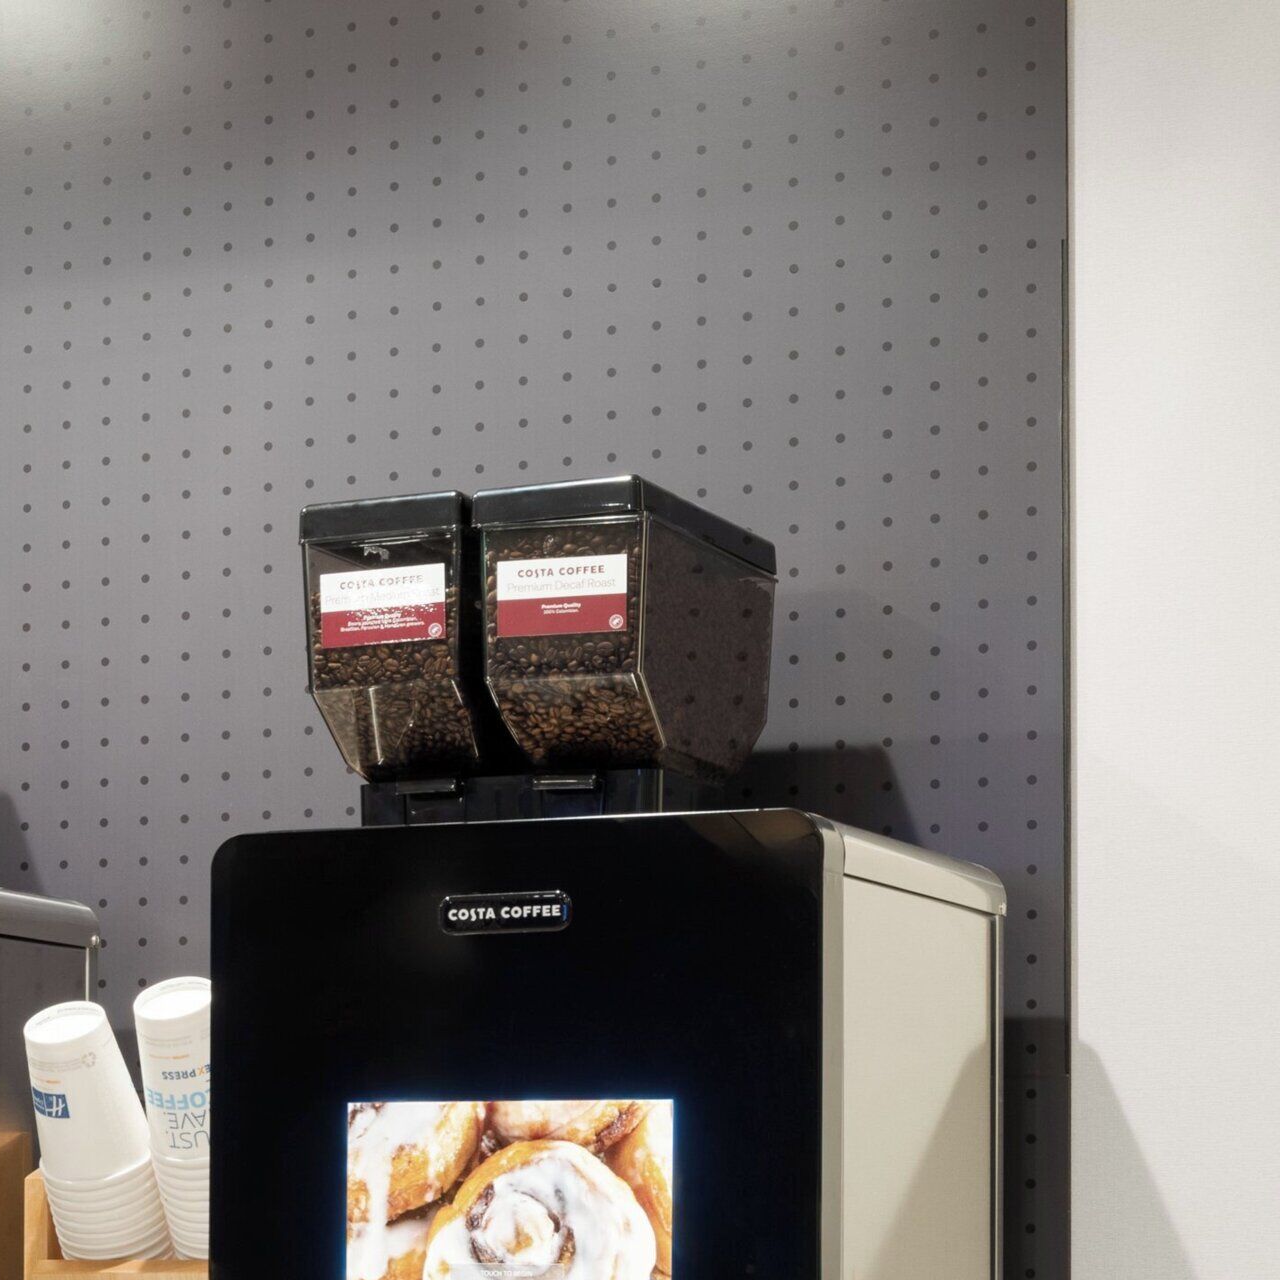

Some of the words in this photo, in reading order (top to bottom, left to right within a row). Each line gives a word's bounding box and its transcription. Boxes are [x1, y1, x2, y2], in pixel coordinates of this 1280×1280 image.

[517, 568, 554, 579] COSTA
[558, 564, 605, 576] COFFEE
[447, 906, 496, 921] COSTA
[500, 904, 561, 918] COFFEE
[161, 1063, 211, 1080] EXPRESS
[145, 1087, 210, 1109] OFFEE
[163, 1109, 207, 1130] AVE.
[165, 1130, 211, 1150] UST.
